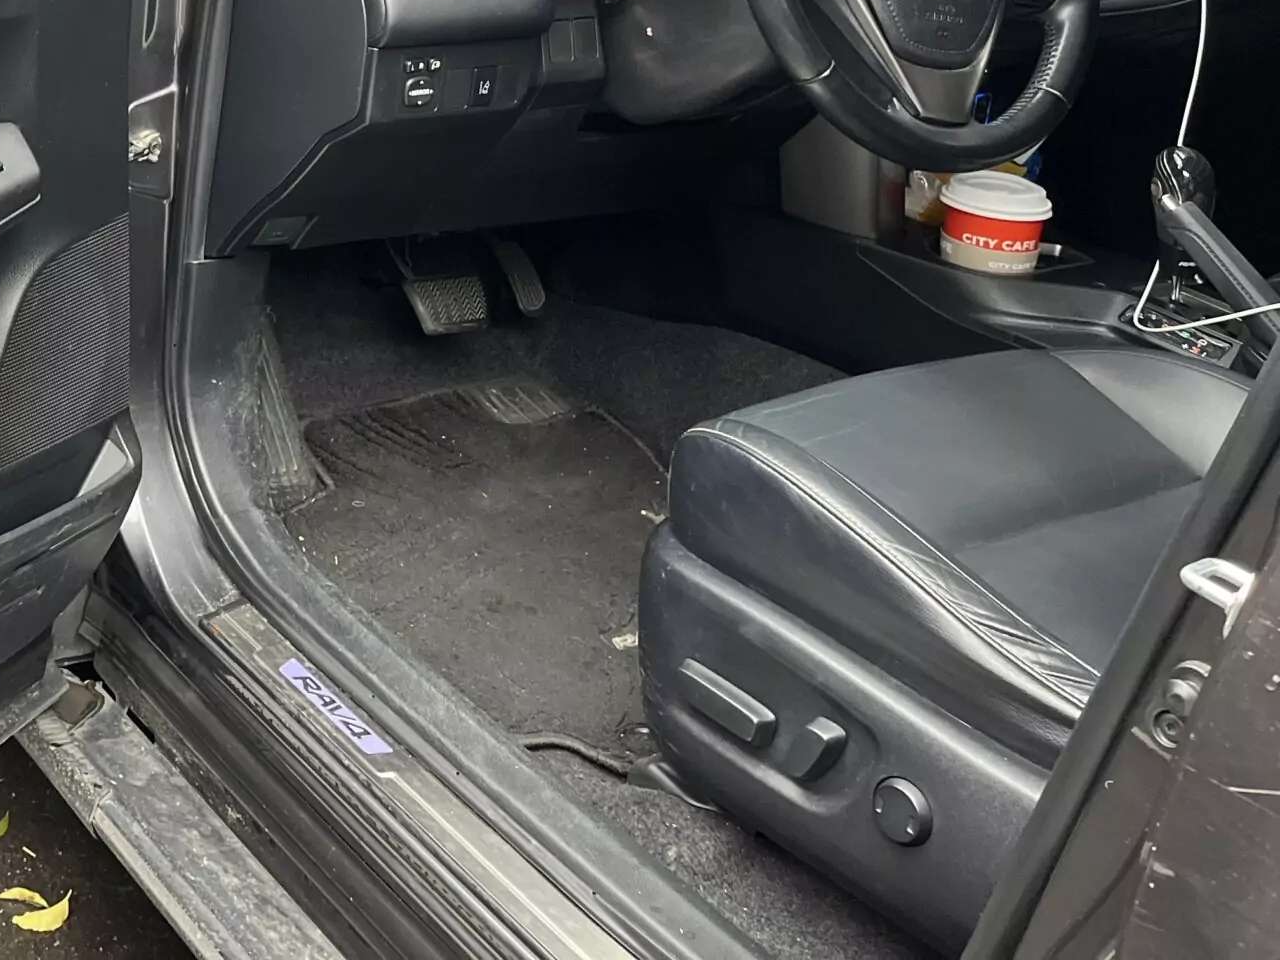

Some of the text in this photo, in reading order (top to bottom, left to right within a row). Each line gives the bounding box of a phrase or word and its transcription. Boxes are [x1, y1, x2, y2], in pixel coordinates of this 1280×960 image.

[962, 233, 999, 249] CITY
[988, 261, 1010, 269] CITY
[291, 675, 373, 741] RAV4
